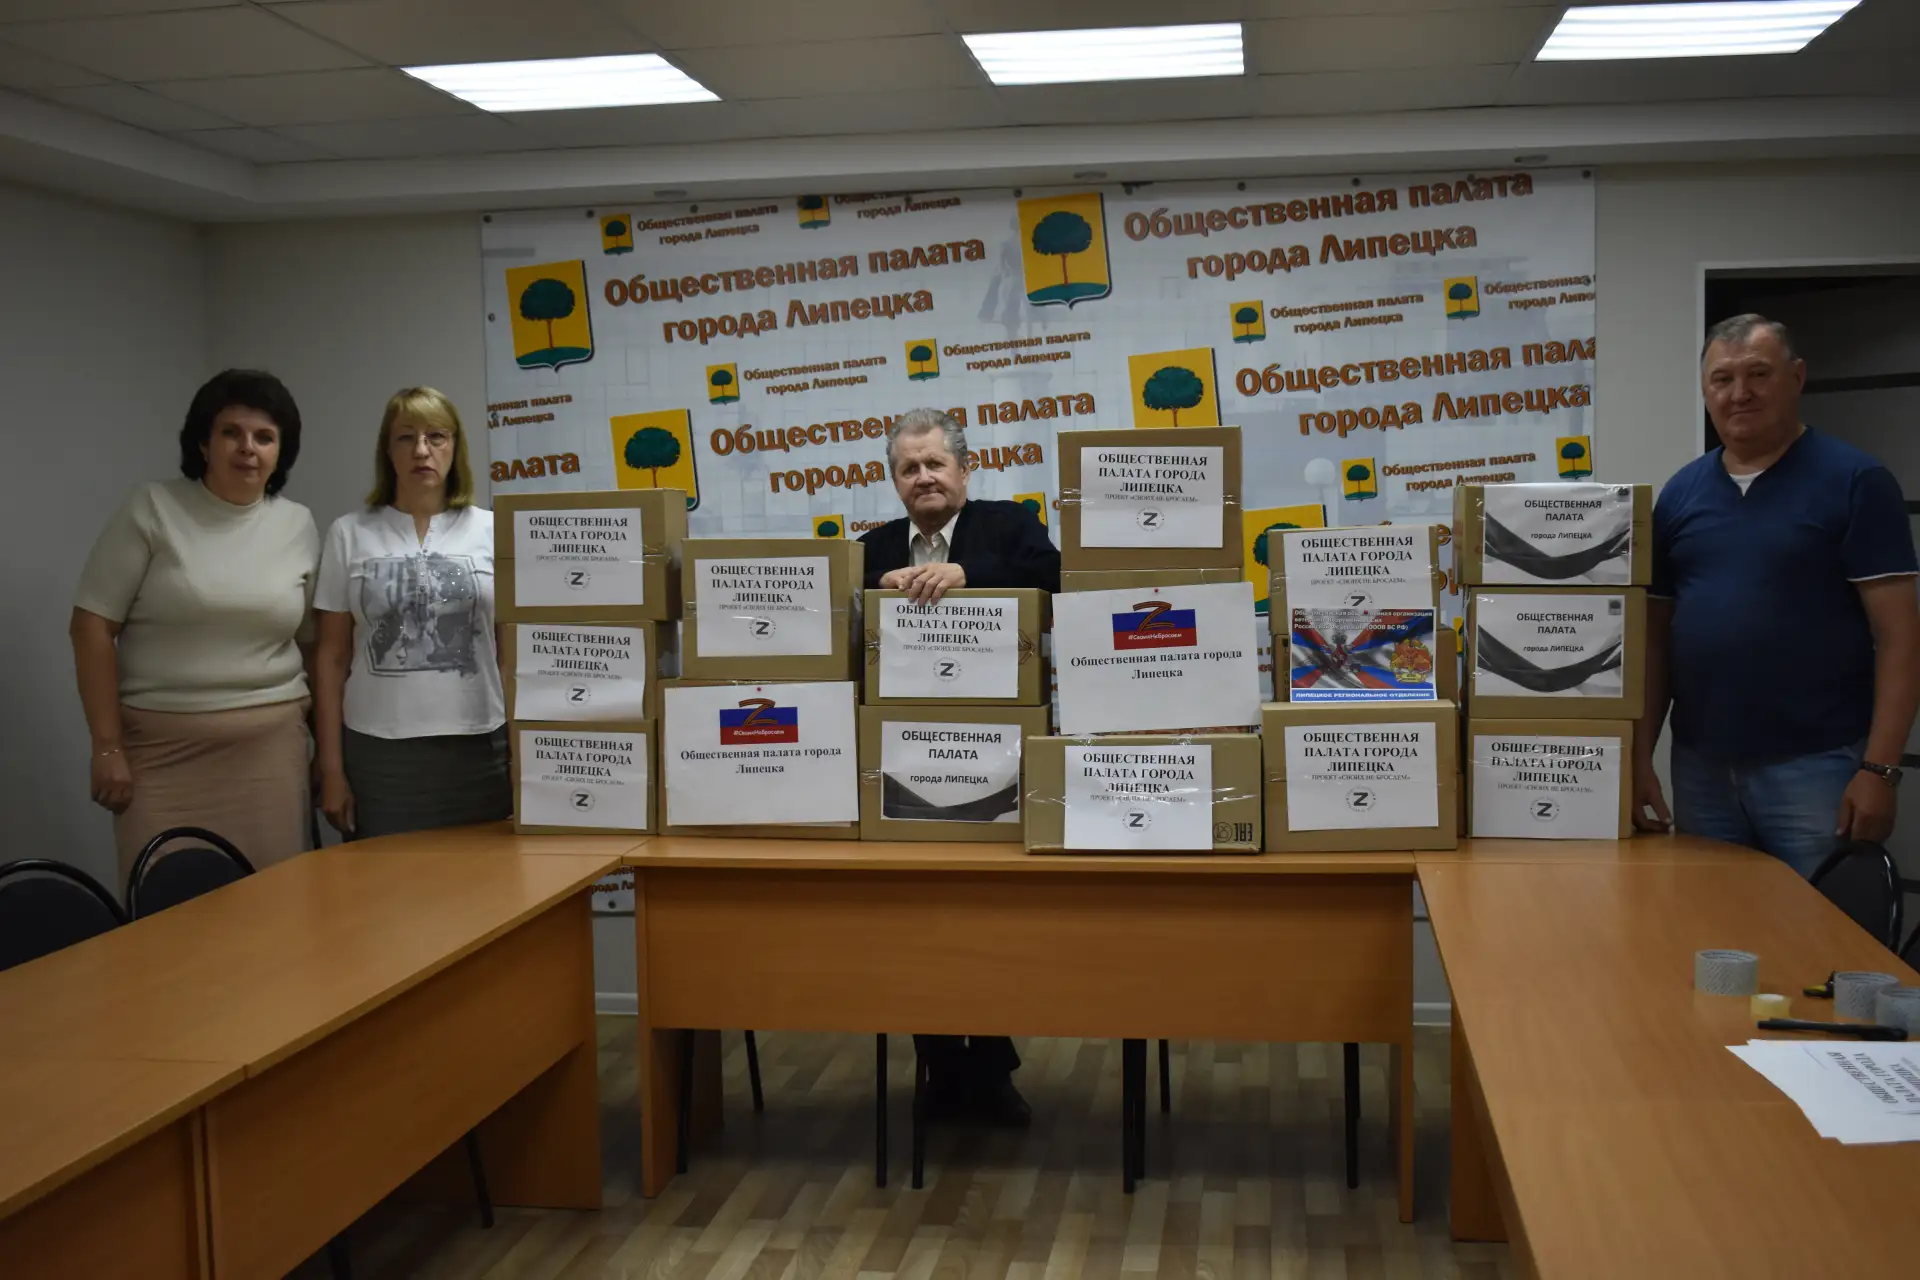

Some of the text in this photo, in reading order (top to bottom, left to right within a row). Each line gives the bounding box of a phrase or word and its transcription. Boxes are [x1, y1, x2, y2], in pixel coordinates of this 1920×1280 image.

[1124, 172, 1534, 241] Общественная палата
[1187, 225, 1478, 281] города Липецка
[604, 238, 986, 306] Общественная палата
[1270, 293, 1424, 319] Общественная палата
[1508, 293, 1556, 310] города
[662, 289, 934, 345] города Липецка
[1294, 312, 1403, 334] города Липецка
[943, 330, 1091, 357] Общественная палата
[966, 350, 1071, 371] города Липецка
[744, 356, 887, 381] Общественная палата
[1236, 346, 1511, 396] Общественная
[766, 374, 868, 395] города Липецка
[977, 392, 1096, 426] палата
[1298, 383, 1591, 438] города Липецка
[1098, 453, 1208, 466] ОБЩЕСТВЕННАЯ
[1382, 452, 1536, 477] Общественная палата
[769, 460, 886, 495] города
[1098, 467, 1206, 481] ПАЛАТА ГОРОДА
[1120, 482, 1183, 494] ЛИПЕЦКА
[1406, 477, 1452, 492] города
[1524, 500, 1602, 509] ОБЩЕСТВЕННАЯ
[529, 516, 628, 527] ОБЩЕСТВЕННАЯ
[1545, 513, 1584, 521] ПАЛАТА
[530, 530, 627, 541] ПАЛАТА ГОРОДА
[1558, 532, 1593, 540] ЛИПЕЦКА
[549, 544, 606, 554] ЛИПЕЦКА
[1301, 536, 1413, 549] ОБЩЕСТВЕННАЯ
[1302, 550, 1413, 563] ПАЛАТА ГОРОДА
[711, 565, 814, 576] ОБЩЕСТВЕННАЯ
[1325, 566, 1390, 577] ЛИПЕЦКА
[712, 579, 814, 590] ПАЛАТА ГОРОДА
[733, 592, 792, 603] ЛИПЕЦКА
[896, 605, 1003, 617] ОБЩЕСТВЕННАЯ
[1516, 613, 1593, 622] ОБЩЕСТВЕННАЯ
[897, 619, 1001, 631] ПАЛАТА ГОРОДА
[1537, 626, 1576, 634] ПАЛАТА
[532, 631, 631, 645] ОБЩЕСТВЕННАЯ
[918, 633, 979, 644] ЛИПЕЦКА
[532, 644, 630, 659] ПАЛАТА ГОРОДА
[551, 659, 609, 671] ЛИПЕЦКА
[1070, 650, 1242, 667] Общественная палата города
[1132, 669, 1183, 680] Липецка
[902, 730, 1001, 743] ОБЩЕСТВЕННАЯ
[1303, 732, 1419, 743] ОБЩЕСТВЕННАЯ
[535, 737, 633, 751] ОБЩЕСТВЕННАЯ
[1491, 742, 1603, 757] ОБЩЕСТВЕННАЯ
[536, 750, 632, 765] ПАЛАТА ГОРОДА
[681, 747, 842, 761] Общественная палата города
[929, 749, 978, 760] ПАЛАТА
[1083, 752, 1195, 765] ОБЩЕСТВЕННАЯ
[1304, 747, 1418, 758] ПАЛАТА ГОРОДА
[555, 764, 611, 777] ЛИПЕЦКА
[736, 764, 784, 774] Липецка
[1328, 762, 1394, 772] ЛИПЕЦКА
[1491, 757, 1602, 771] ПАЛАТА ГОРОДА
[910, 775, 988, 785] города ЛИПЕЦКА
[1083, 767, 1194, 781] ПАЛАТА ГОРОДА
[1513, 772, 1578, 784] ЛИПЕЦКА
[1106, 783, 1170, 794] ЛИПЕЦКА
